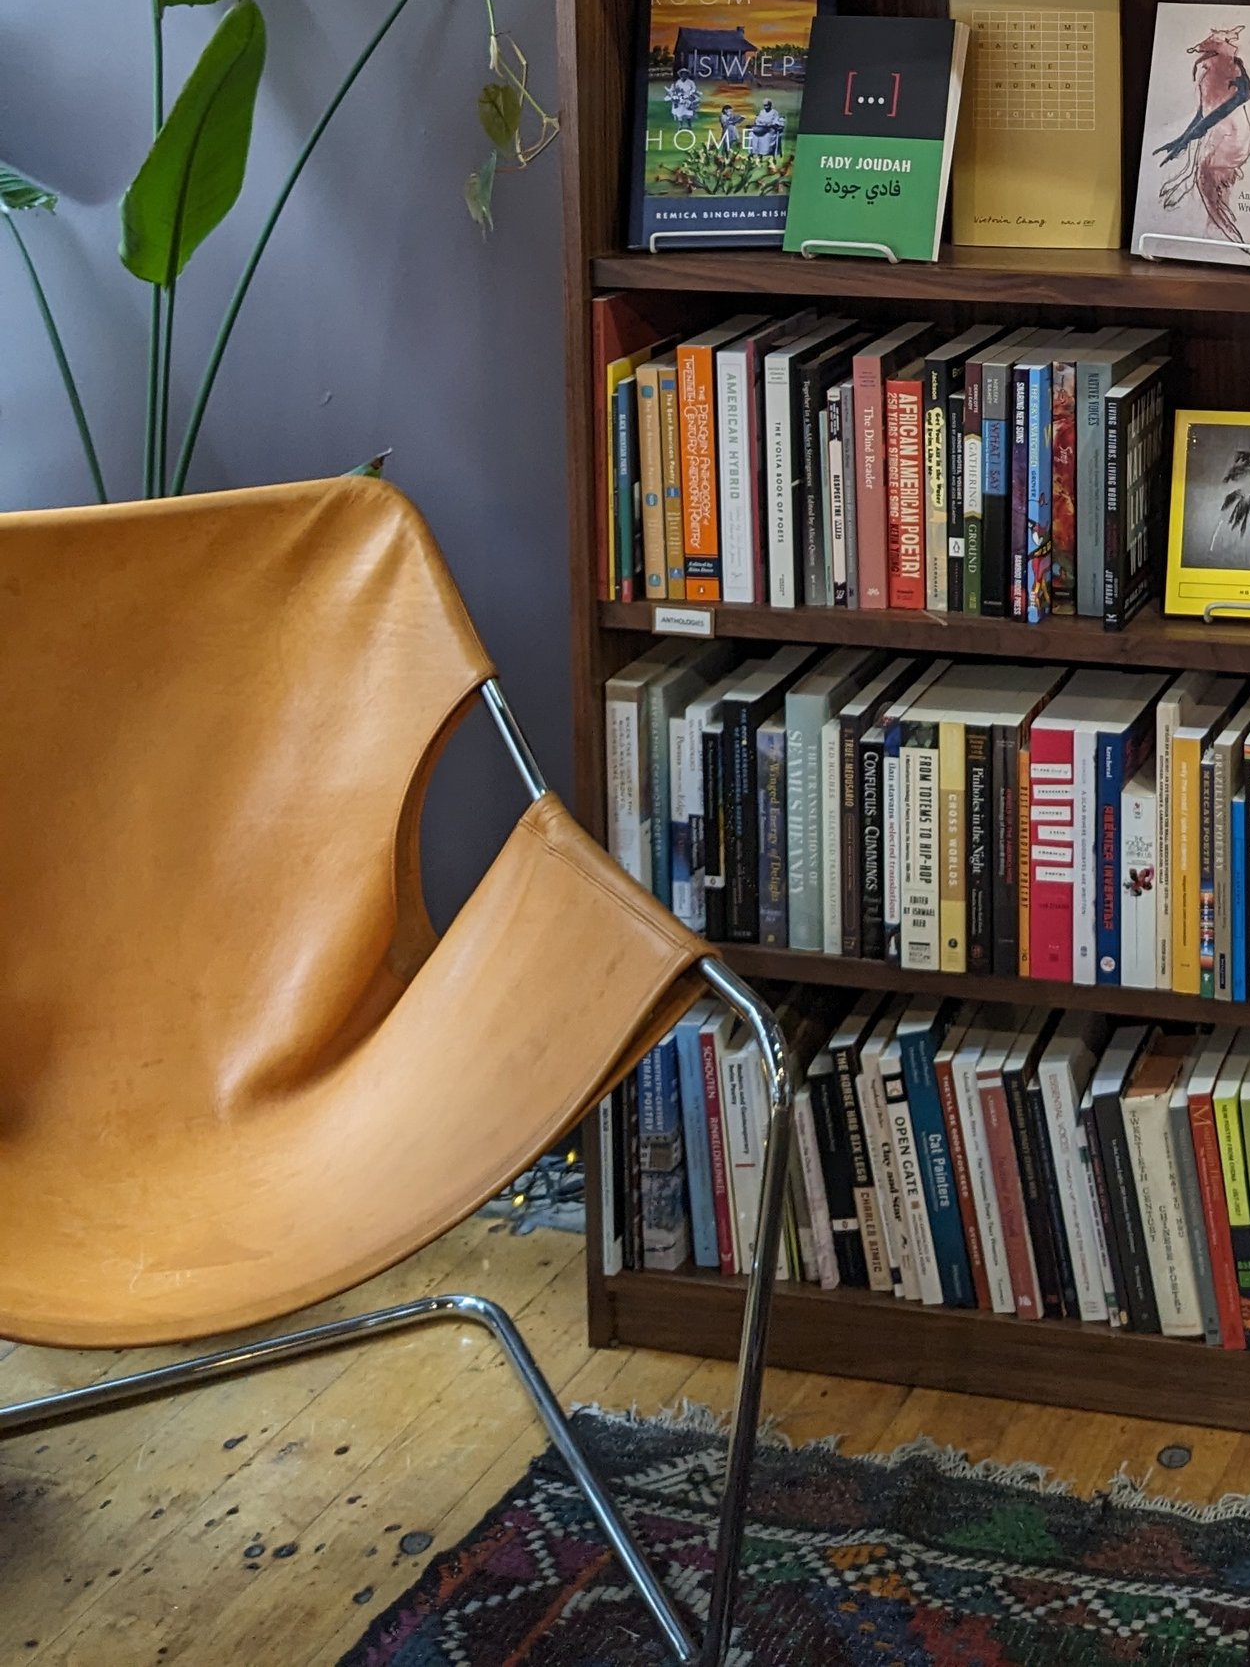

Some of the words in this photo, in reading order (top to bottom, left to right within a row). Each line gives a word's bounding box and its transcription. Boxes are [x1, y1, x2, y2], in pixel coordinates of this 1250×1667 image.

[646, 129, 754, 151] HOME
[821, 156, 852, 170] FADY
[856, 157, 911, 173] JOUDAH
[824, 177, 862, 198] جودة
[866, 179, 900, 204] فادي
[898, 393, 916, 456] AFRICAN
[899, 459, 919, 525] AMERICAN
[902, 528, 920, 579] POETRY
[661, 616, 703, 627] ANTHOLOGIES
[864, 752, 878, 816] CONFUCIUS
[865, 826, 879, 890] CUMMINGS
